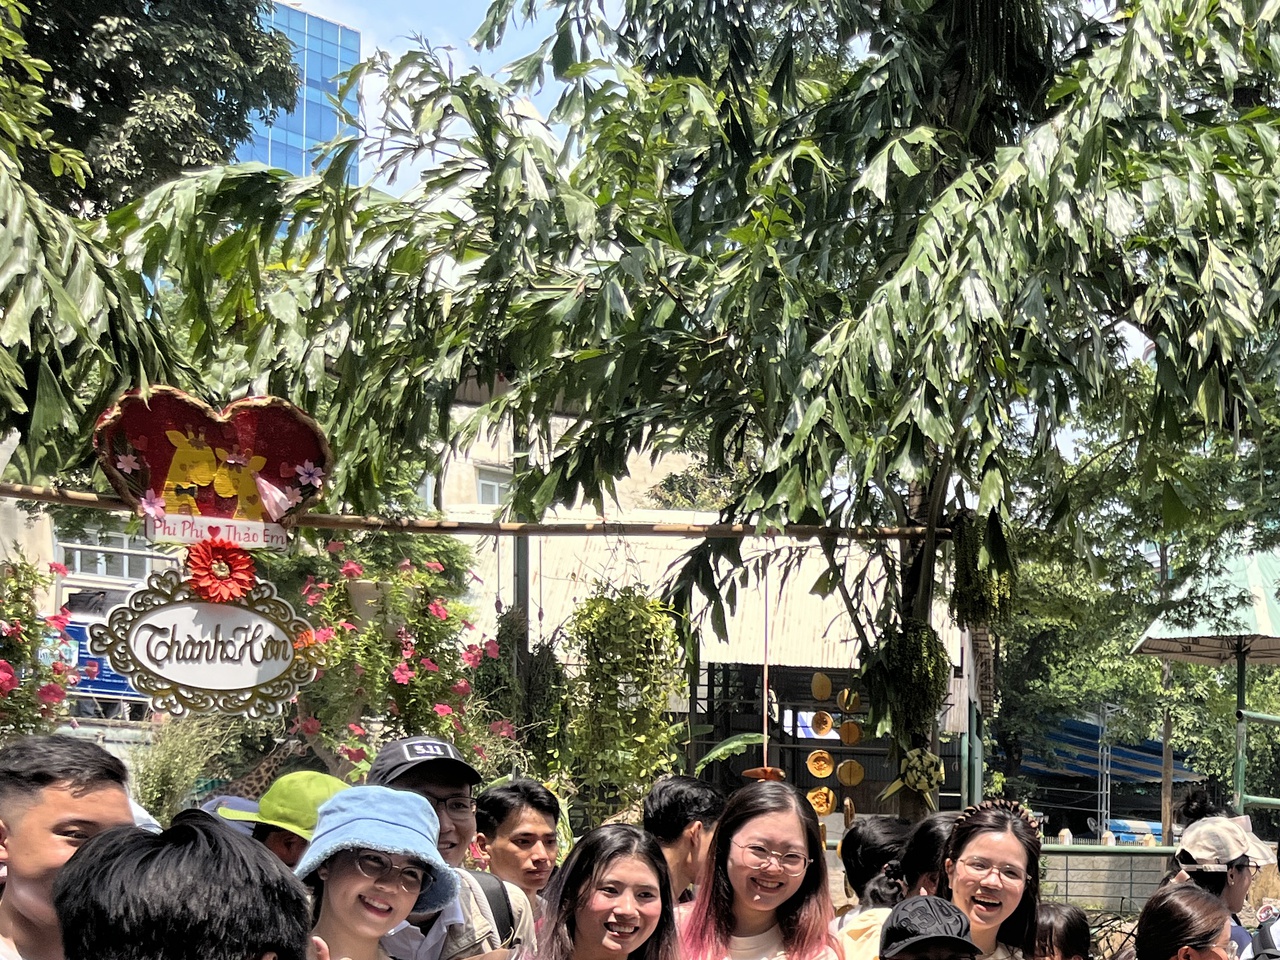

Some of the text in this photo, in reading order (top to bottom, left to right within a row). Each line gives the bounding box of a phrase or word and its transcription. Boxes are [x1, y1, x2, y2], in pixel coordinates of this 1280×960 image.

[152, 520, 286, 545] Phi Phi Thảo Em
